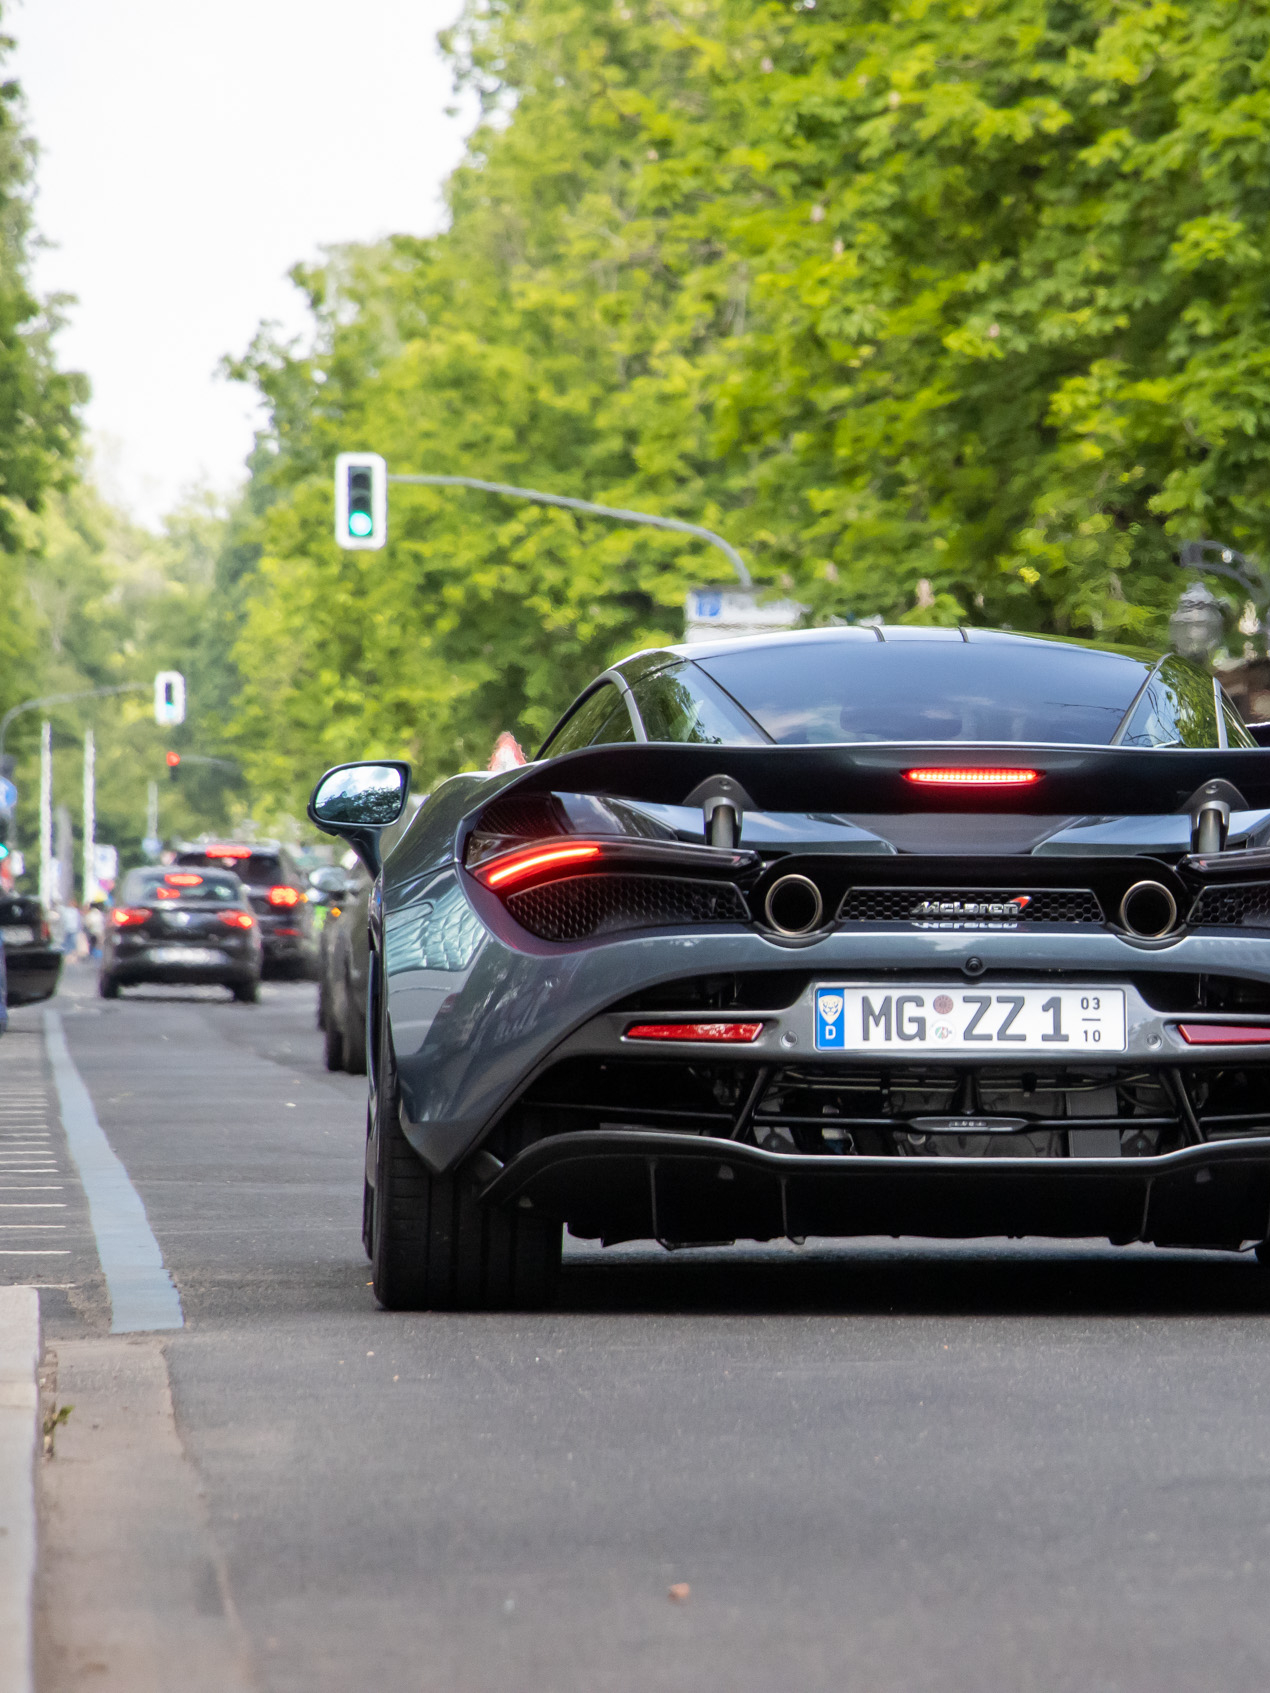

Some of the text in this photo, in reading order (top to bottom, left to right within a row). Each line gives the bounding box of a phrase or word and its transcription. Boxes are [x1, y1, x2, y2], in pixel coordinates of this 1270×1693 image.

[911, 901, 1018, 914] McLaren
[1081, 997, 1101, 1010] 03
[862, 995, 1069, 1042] MG ZZ 1
[824, 1026, 836, 1040] D
[1083, 1030, 1101, 1042] 10
